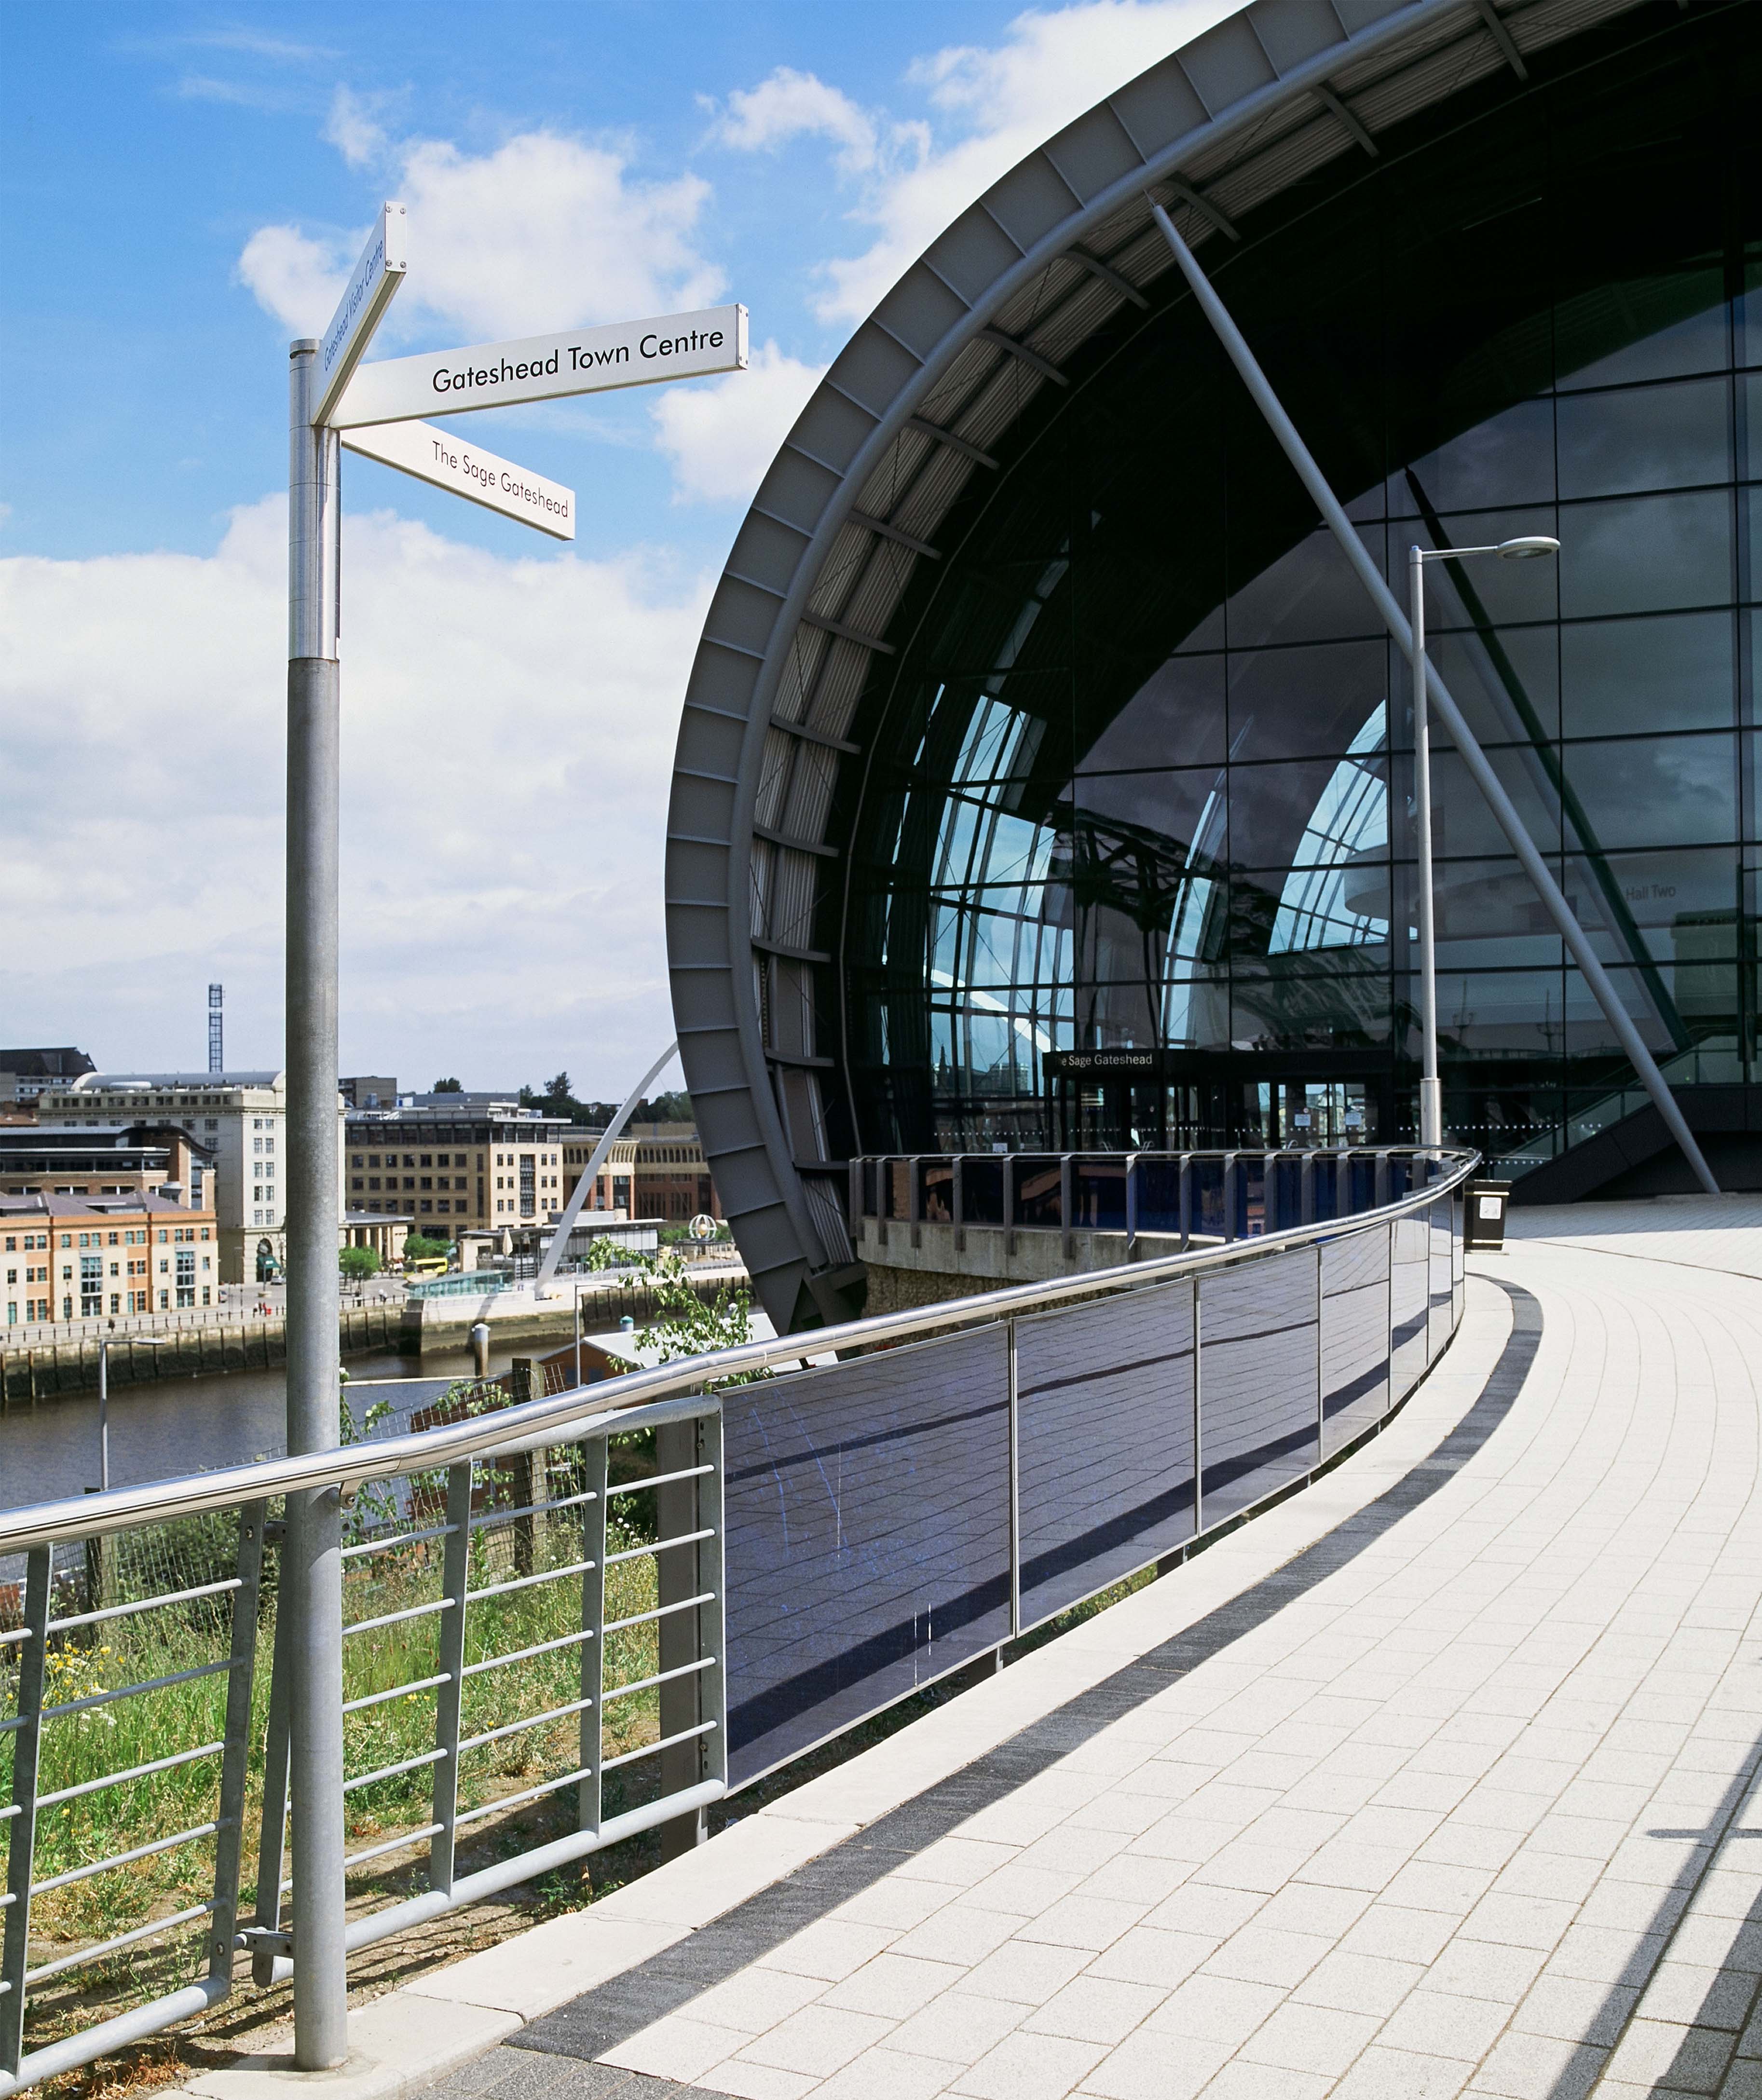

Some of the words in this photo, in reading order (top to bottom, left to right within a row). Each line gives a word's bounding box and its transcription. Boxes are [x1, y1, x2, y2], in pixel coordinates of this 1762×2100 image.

[324, 303, 349, 372] Gateshead
[348, 278, 365, 318] Visitor
[365, 239, 383, 288] Centre
[432, 349, 559, 393] Gateshead
[567, 346, 629, 371] Town
[640, 329, 724, 359] Centre
[432, 441, 458, 469] The
[463, 456, 496, 487] Sage
[501, 473, 569, 518] Gateshead
[1626, 886, 1648, 900] Hall
[1651, 884, 1676, 899] Two
[1068, 1055, 1091, 1068] Sage
[1094, 1053, 1153, 1065] Gateshead
